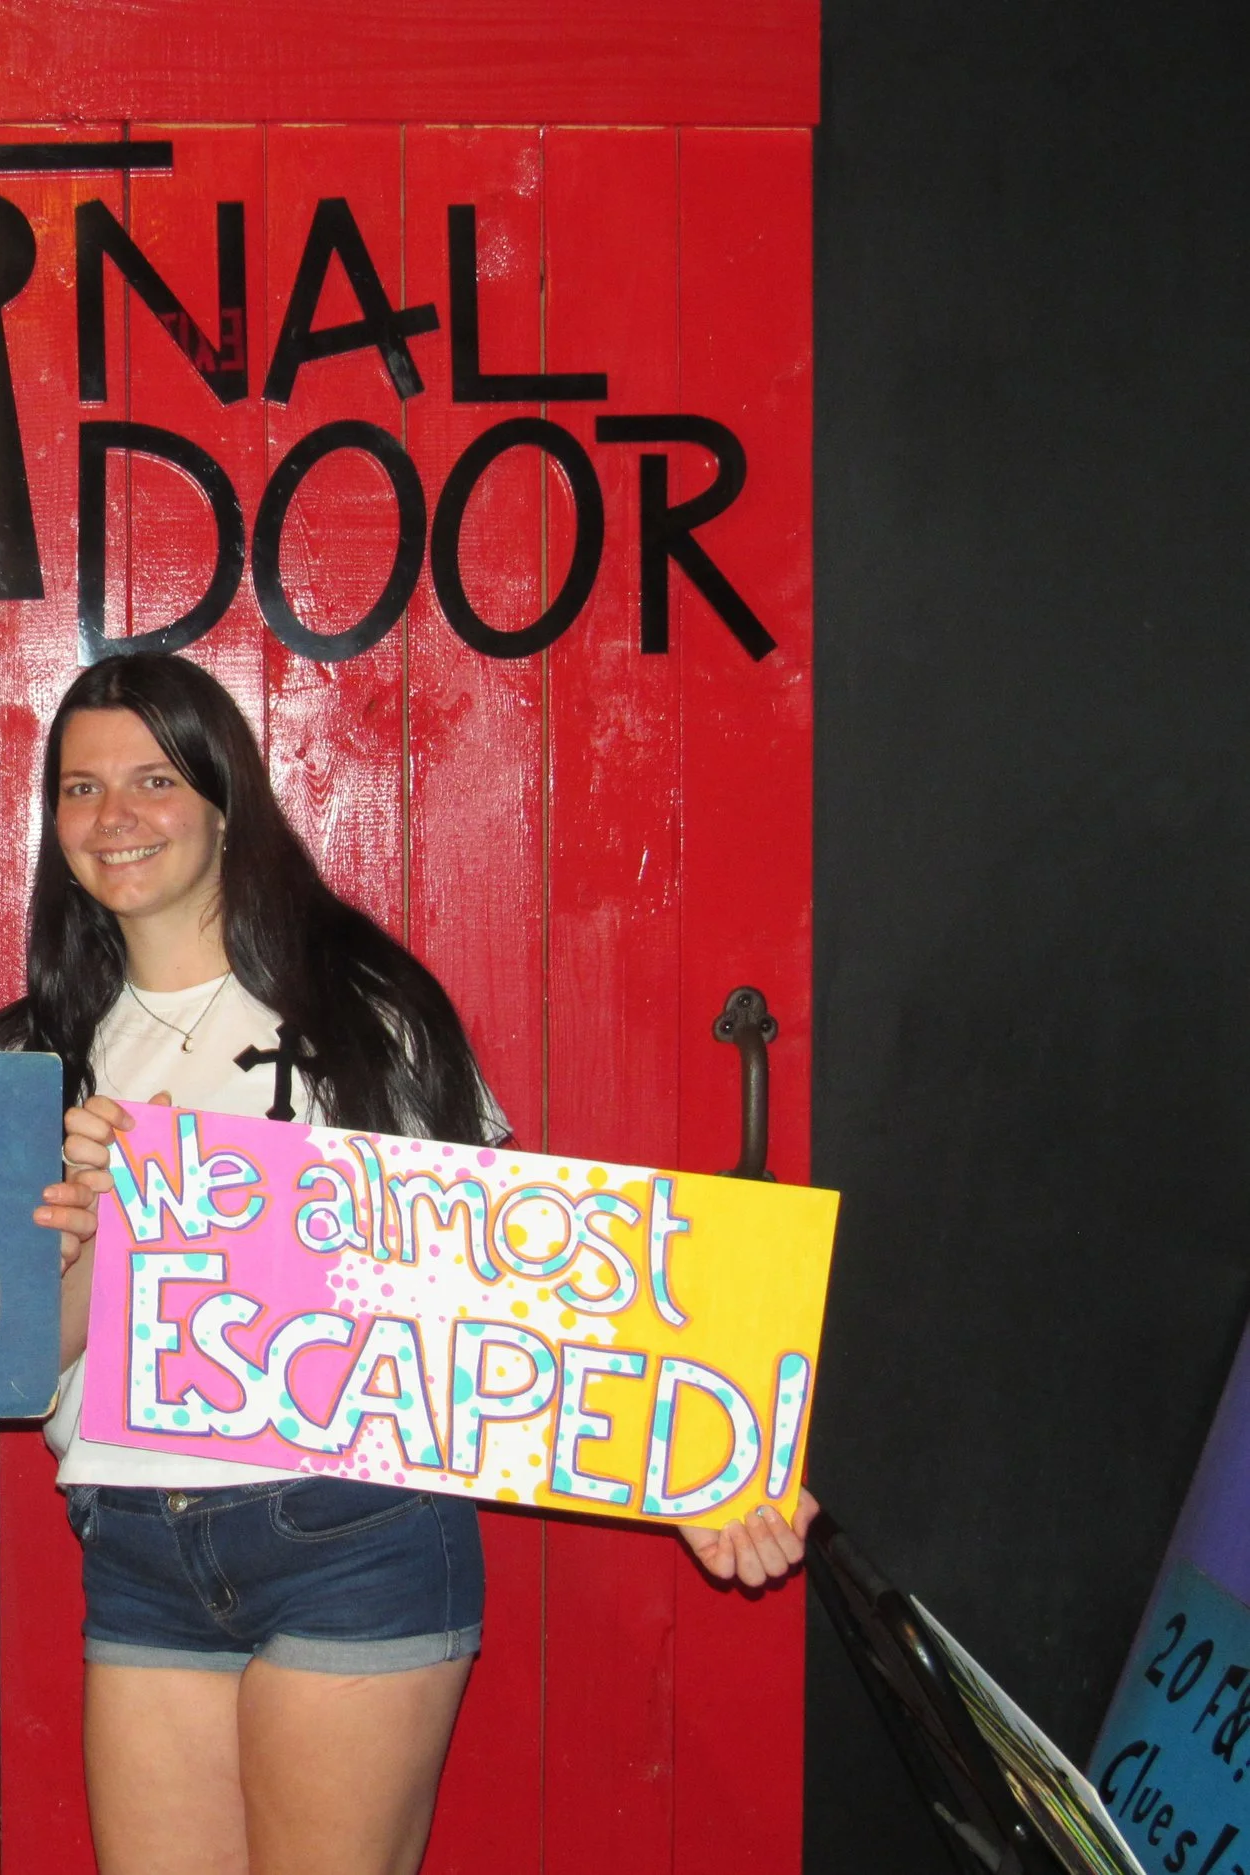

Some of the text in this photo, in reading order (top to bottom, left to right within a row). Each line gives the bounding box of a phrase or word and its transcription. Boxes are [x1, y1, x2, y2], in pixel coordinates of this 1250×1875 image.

[77, 413, 777, 662] DOOR
[107, 1112, 692, 1328] We almost
[127, 1250, 811, 1518] ESCAPED!
[1145, 1612, 1215, 1703] 20
